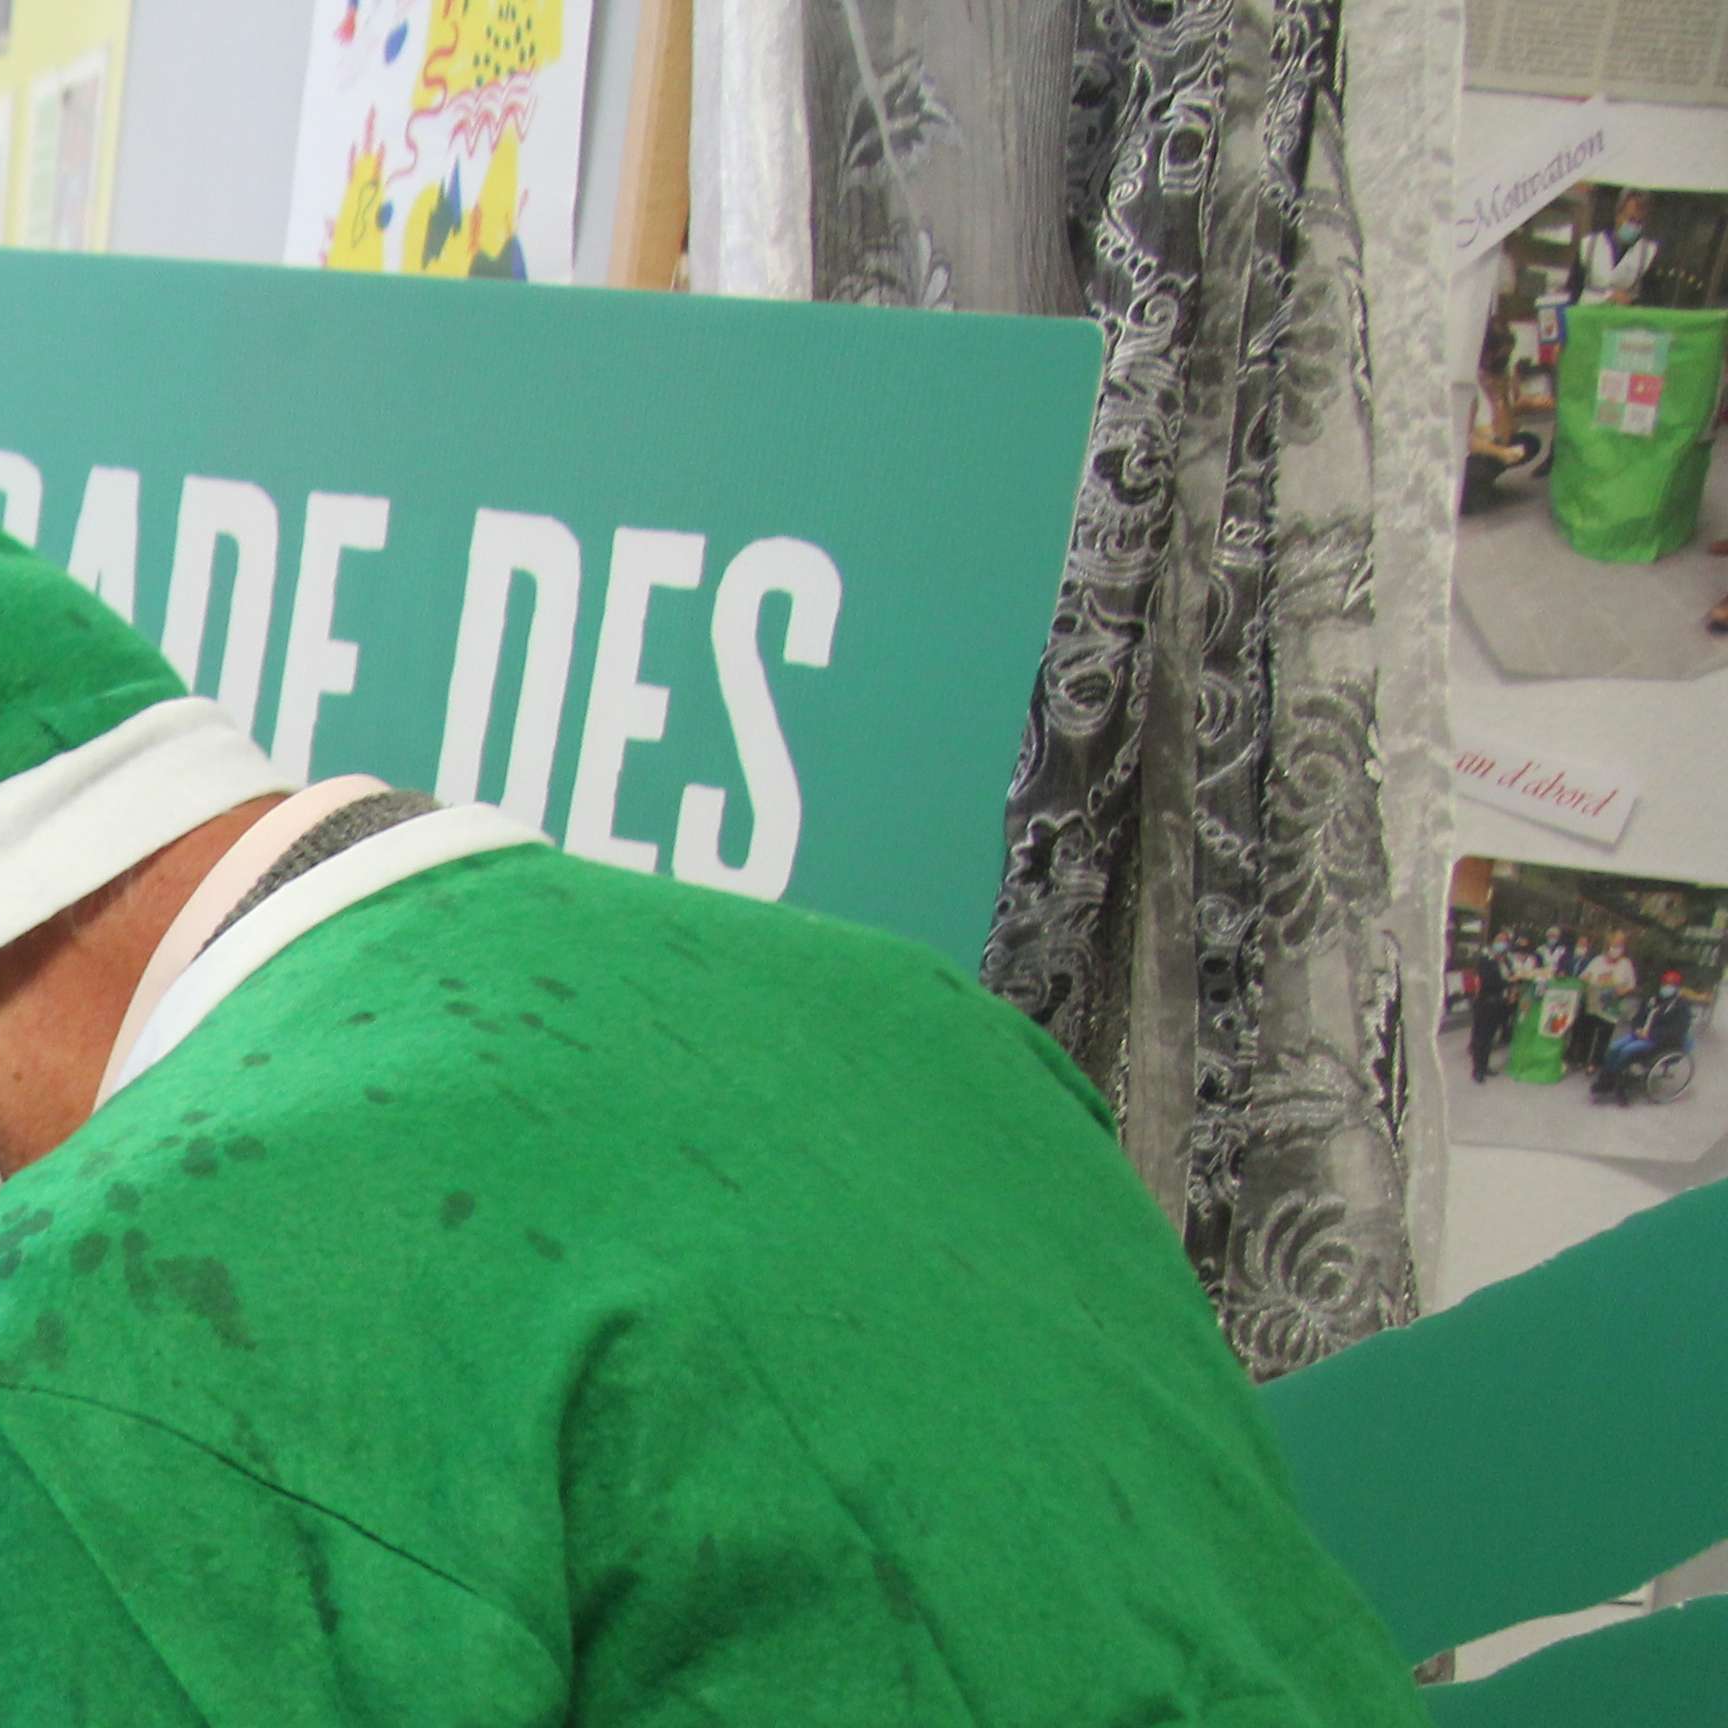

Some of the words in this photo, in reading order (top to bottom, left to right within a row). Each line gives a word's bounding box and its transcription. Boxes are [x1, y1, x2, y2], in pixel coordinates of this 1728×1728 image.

[1455, 128, 1604, 248] Motivation
[434, 507, 842, 901] DES
[1497, 760, 1619, 817] d'abord
